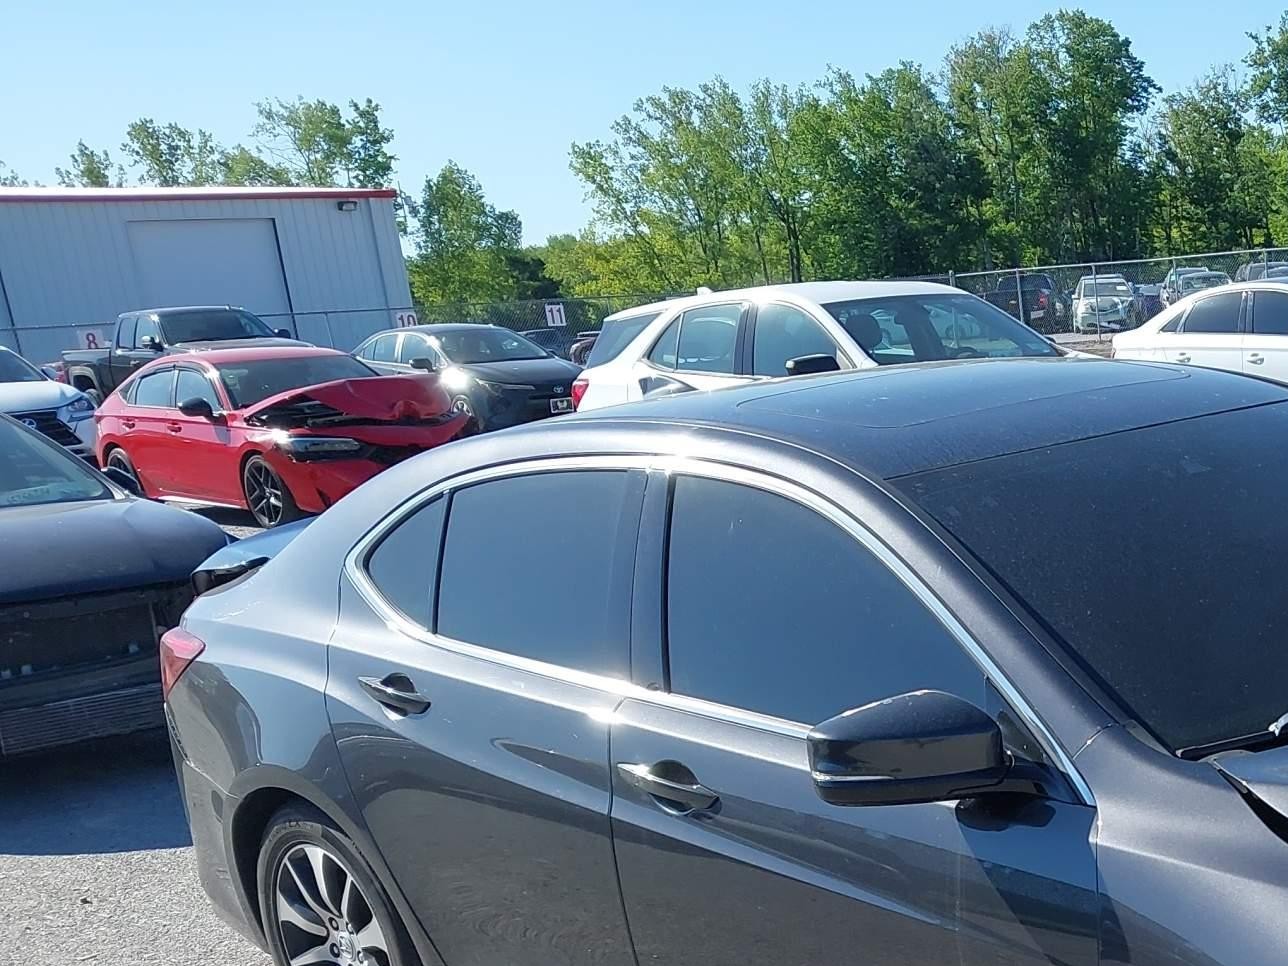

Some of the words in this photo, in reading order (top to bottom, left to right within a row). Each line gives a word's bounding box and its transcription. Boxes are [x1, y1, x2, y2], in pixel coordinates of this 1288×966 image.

[398, 314, 417, 328] 10
[548, 307, 563, 324] 11
[86, 332, 98, 349] 8
